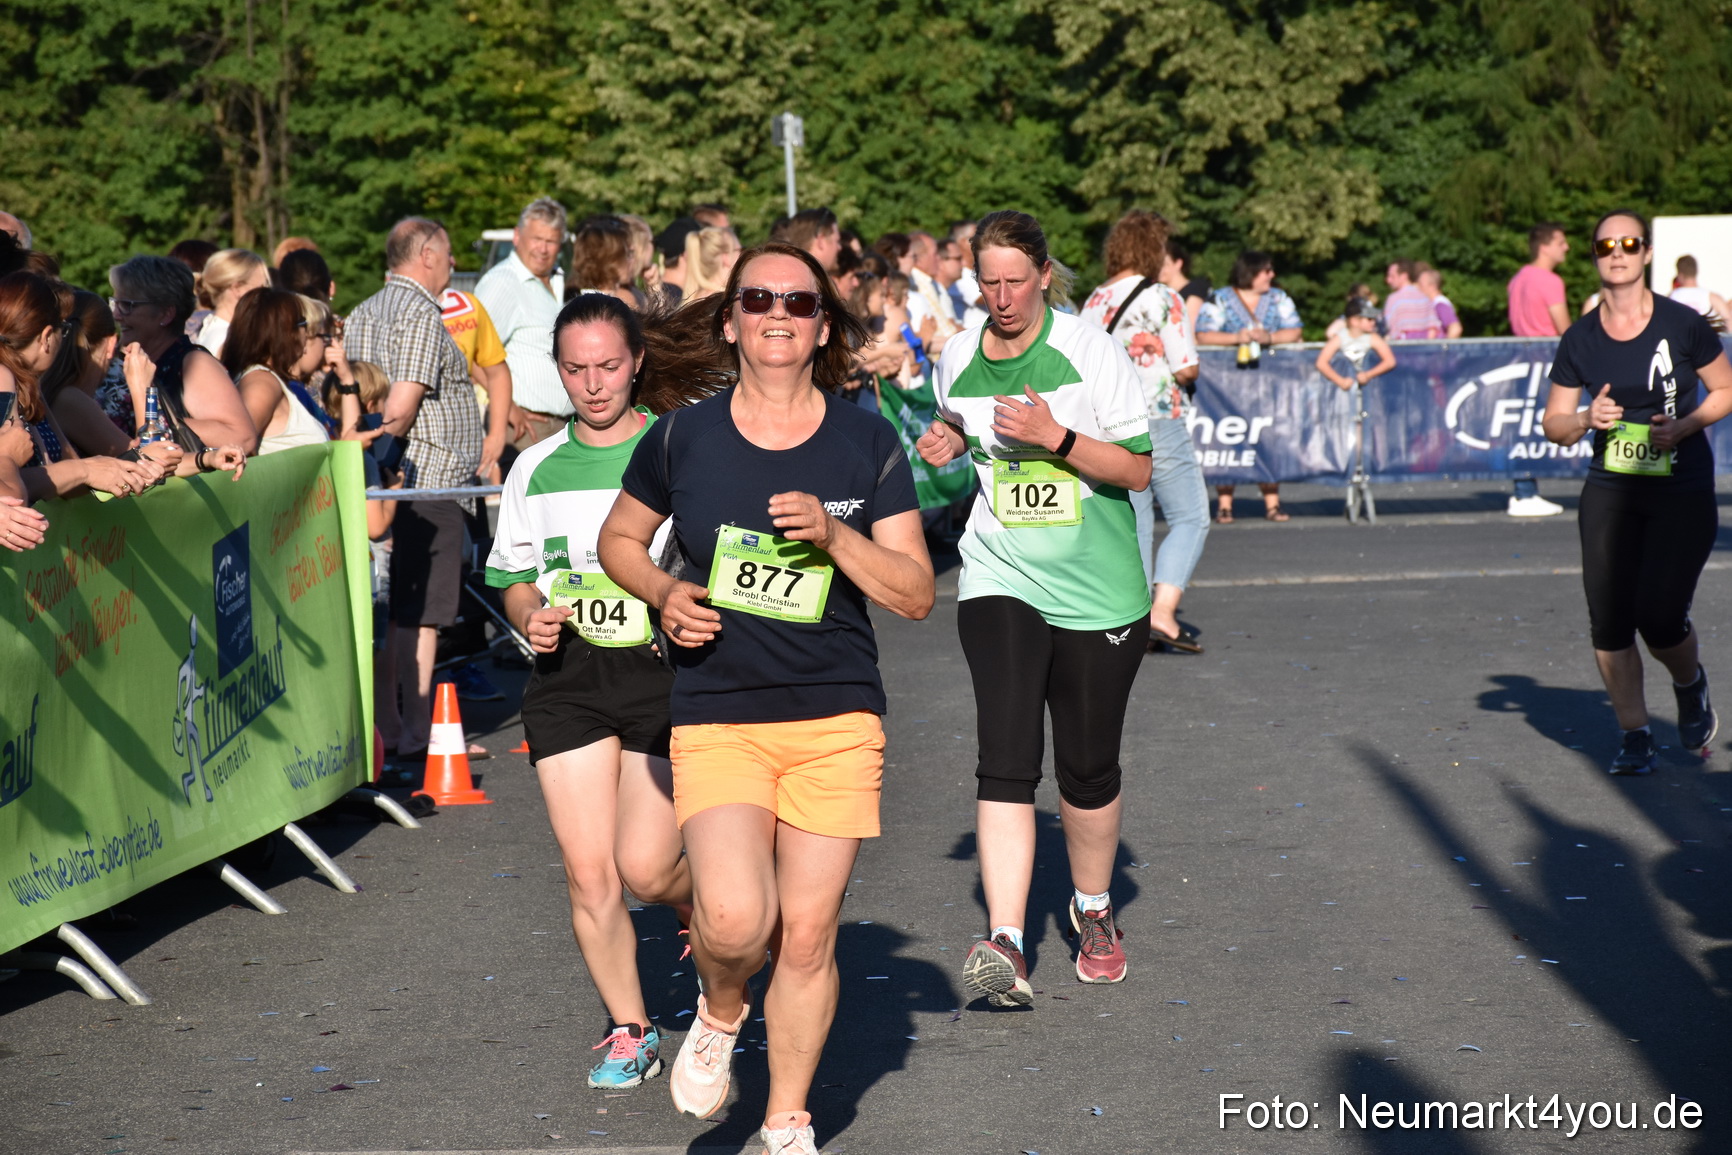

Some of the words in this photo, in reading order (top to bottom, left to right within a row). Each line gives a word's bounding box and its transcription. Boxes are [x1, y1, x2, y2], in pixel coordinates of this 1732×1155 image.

[1186, 407, 1273, 445] her
[1613, 440, 1662, 461] 1609
[1011, 484, 1058, 508] 102
[544, 549, 568, 562] BayWa
[732, 541, 772, 556] firmenlauf
[222, 571, 246, 604] Fischer
[736, 561, 804, 597] 877
[732, 588, 759, 600] Strobl
[761, 595, 800, 608] Christian
[747, 600, 762, 608] Klebl
[763, 602, 782, 612] GmbH
[571, 598, 627, 626] 104
[582, 625, 594, 633] Ott
[595, 626, 616, 634] Maria
[204, 614, 286, 757] firmenlauf
[212, 735, 251, 790] neumarkt
